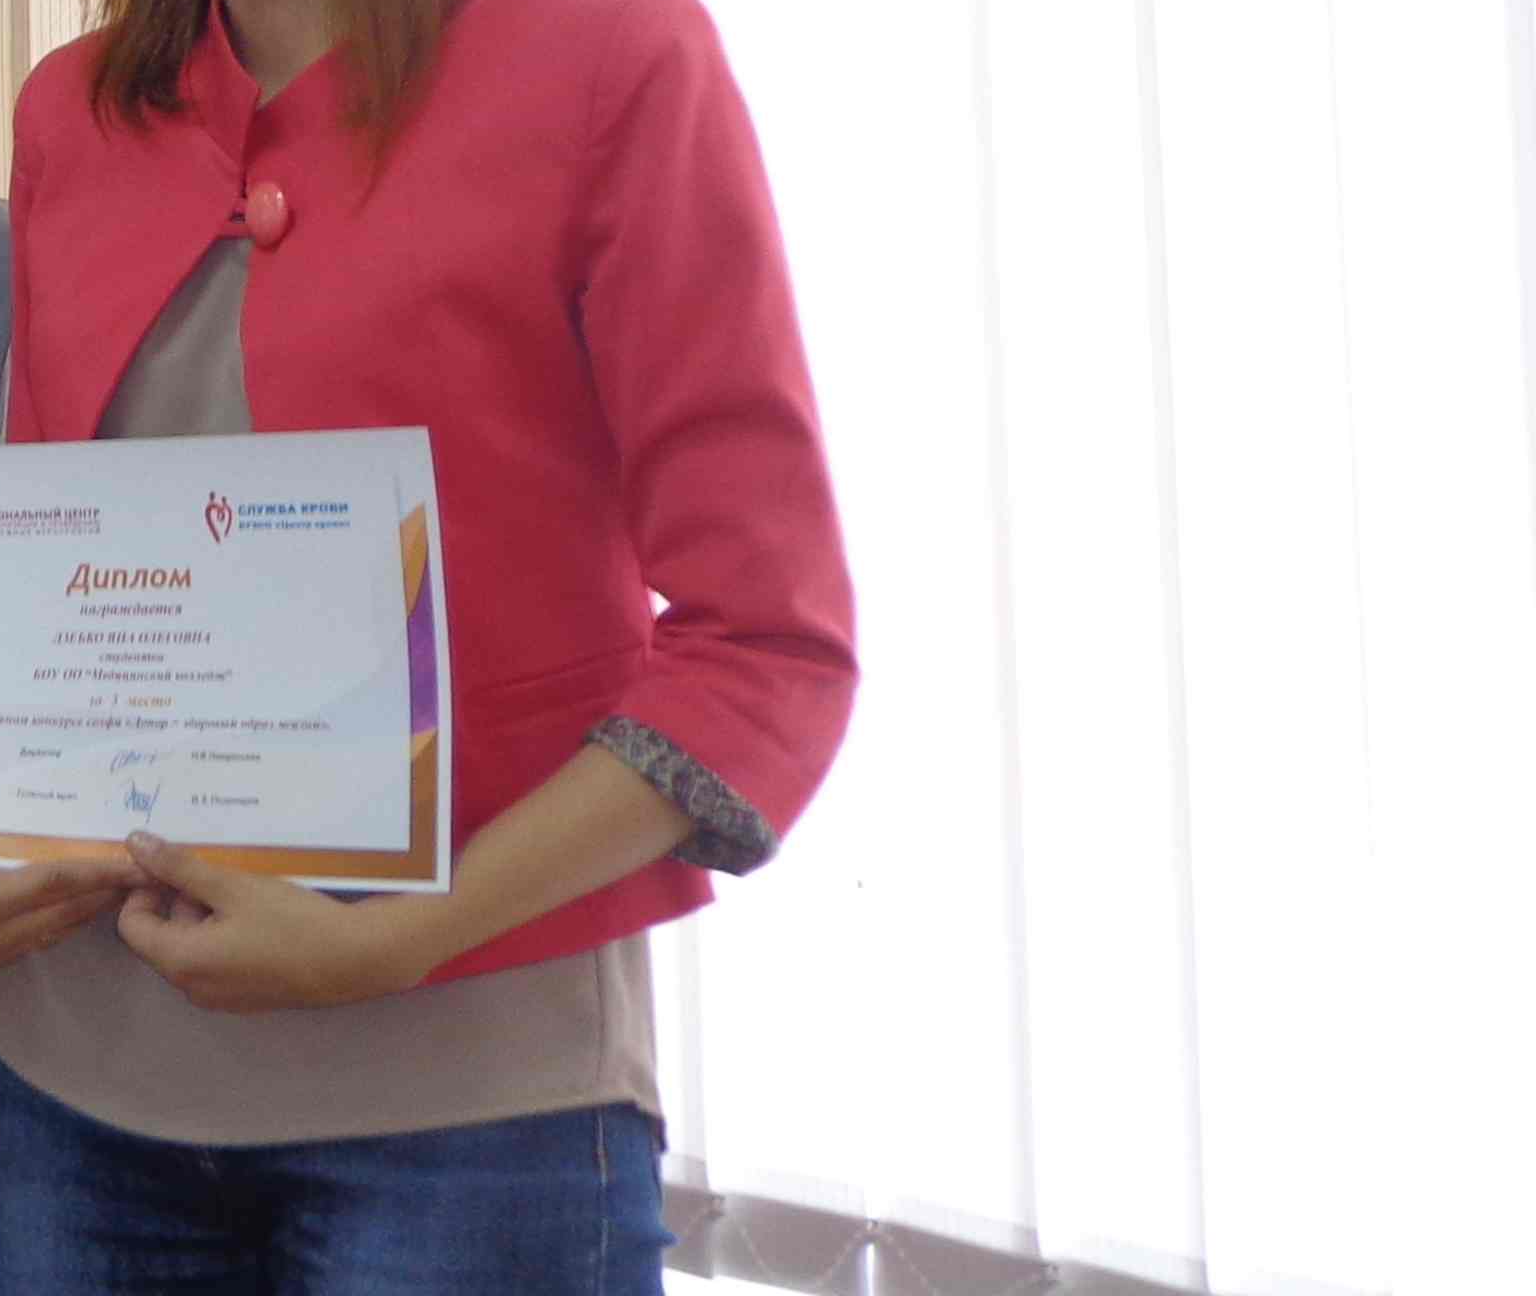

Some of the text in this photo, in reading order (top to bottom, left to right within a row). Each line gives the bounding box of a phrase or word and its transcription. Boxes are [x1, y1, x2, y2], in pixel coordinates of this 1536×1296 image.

[64, 507, 101, 522] ЦЕНТР
[238, 503, 349, 515] СЛУЖБА КРОВИ
[66, 563, 193, 596] Диплом
